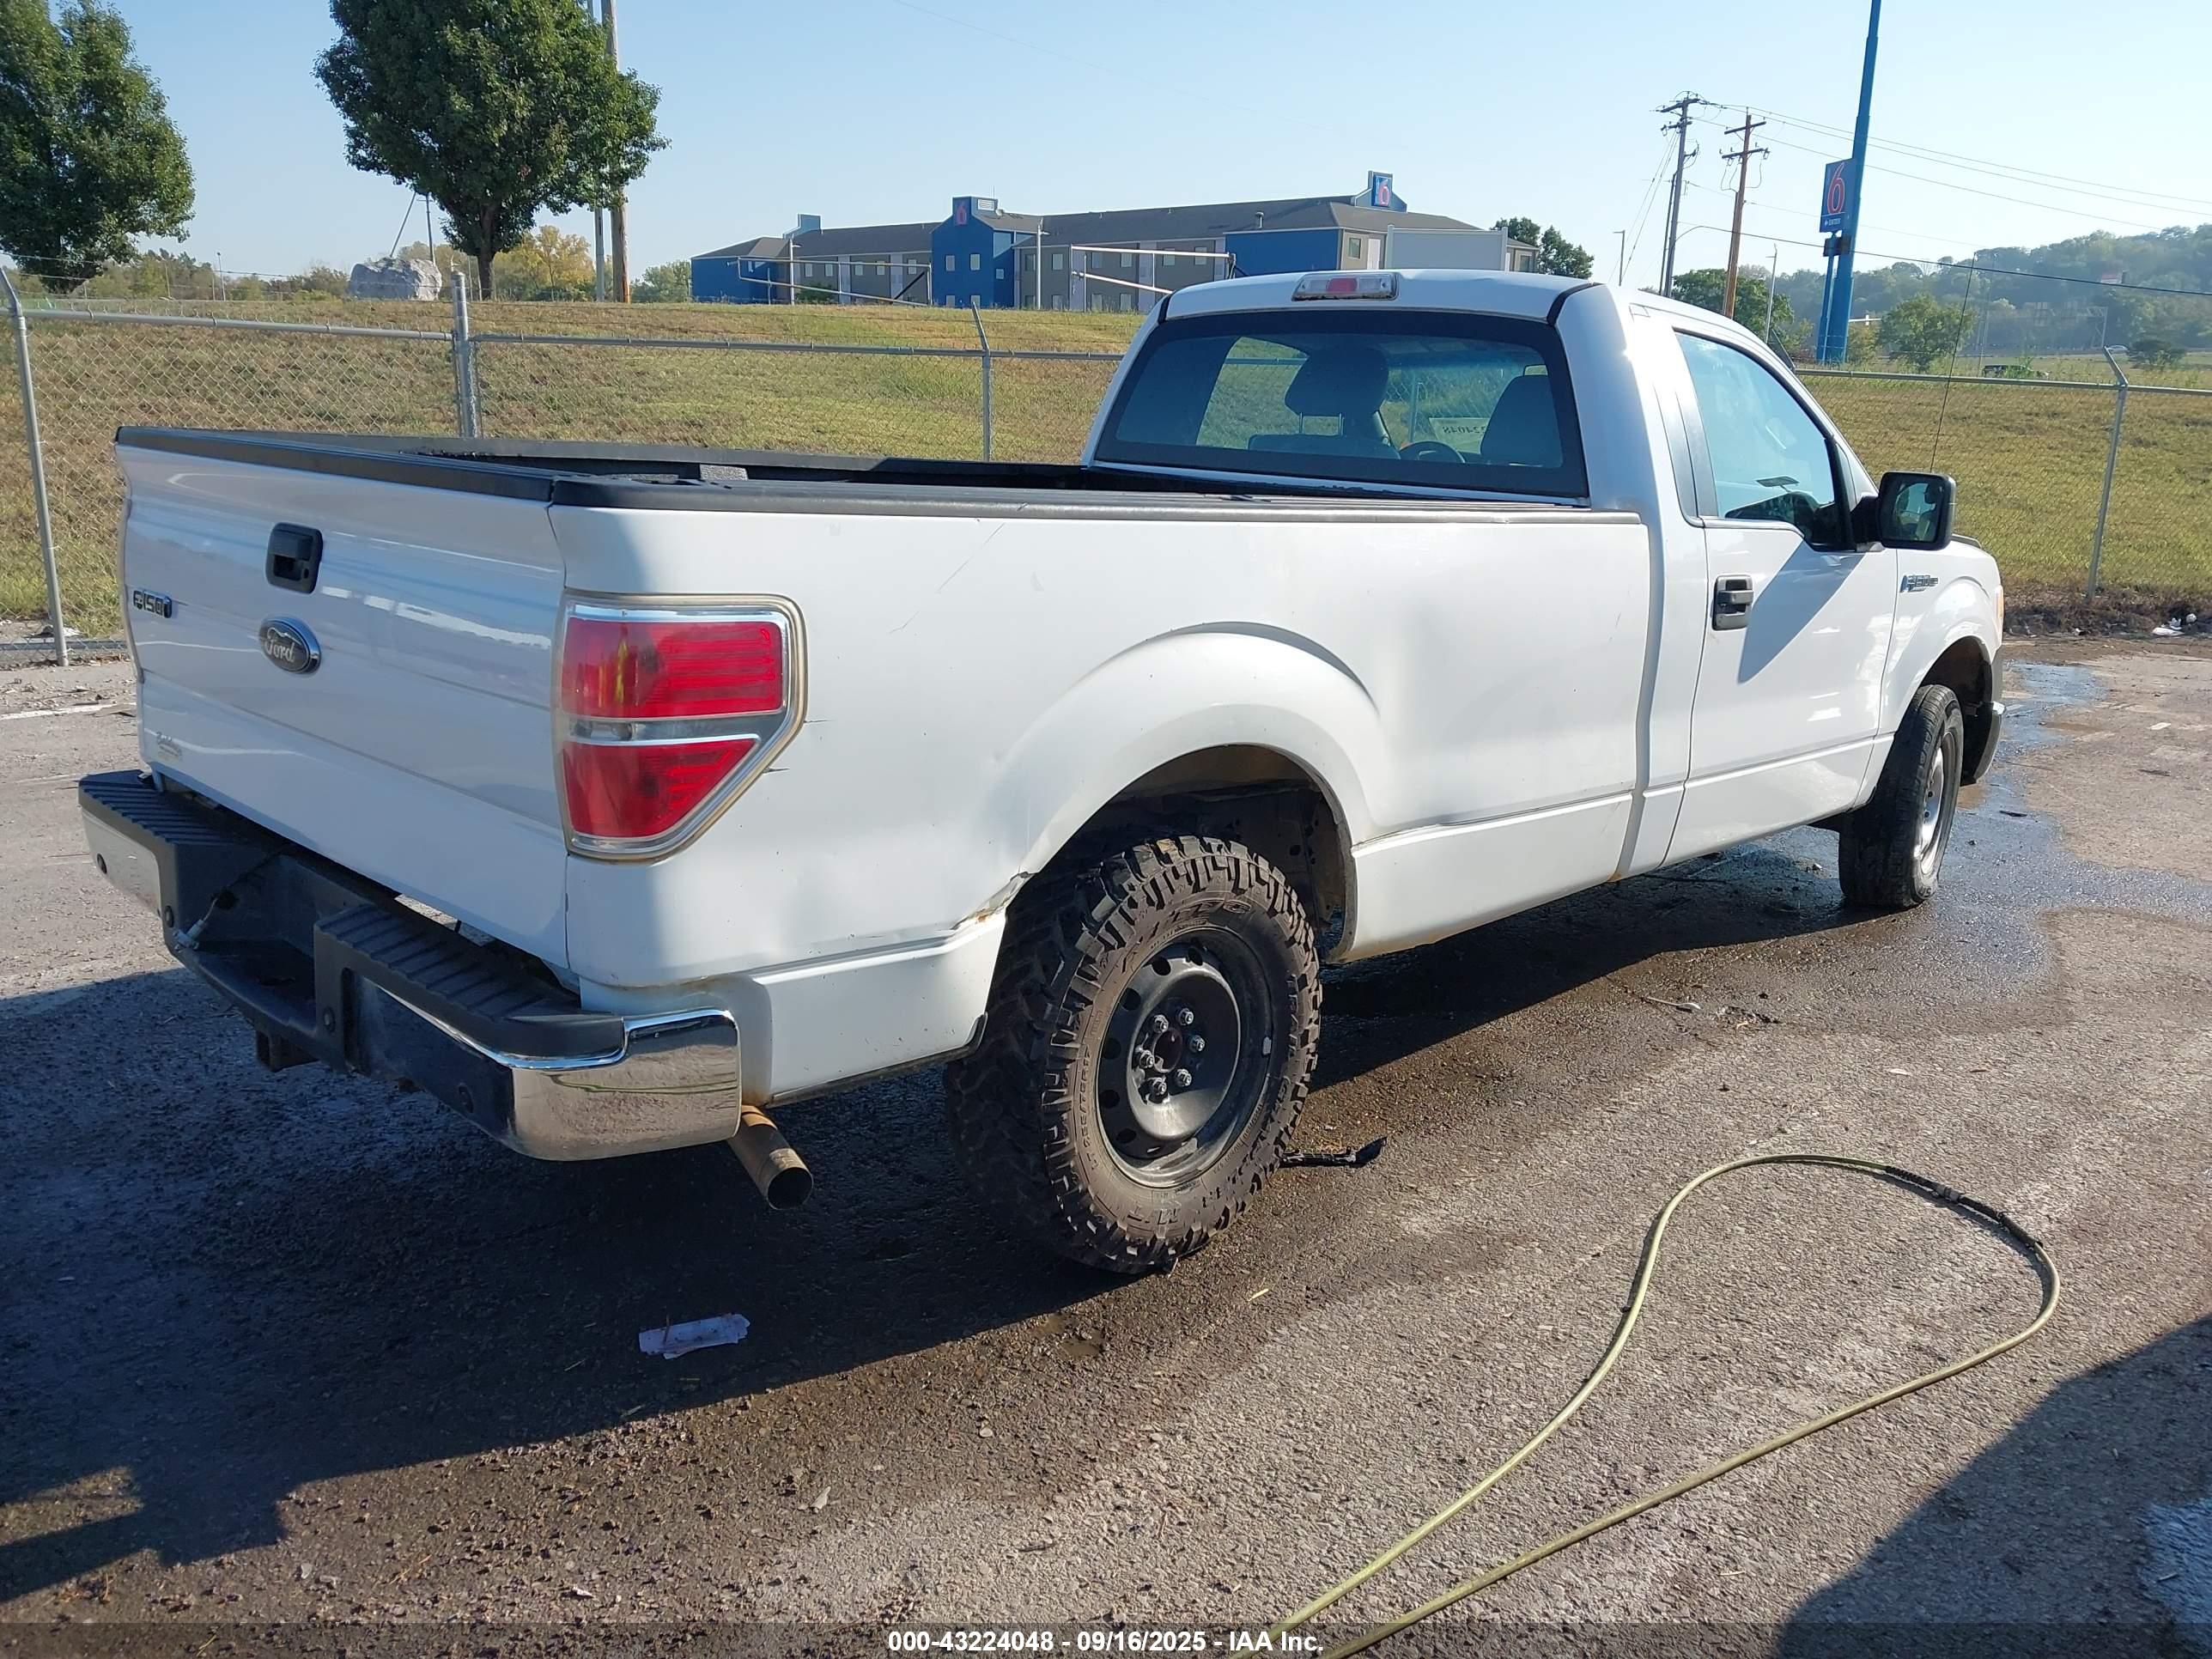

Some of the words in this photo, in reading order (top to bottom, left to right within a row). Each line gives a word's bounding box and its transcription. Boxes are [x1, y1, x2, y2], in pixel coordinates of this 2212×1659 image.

[1378, 179, 1390, 206] 6
[1827, 161, 1845, 214] 6
[264, 627, 302, 663] Ford
